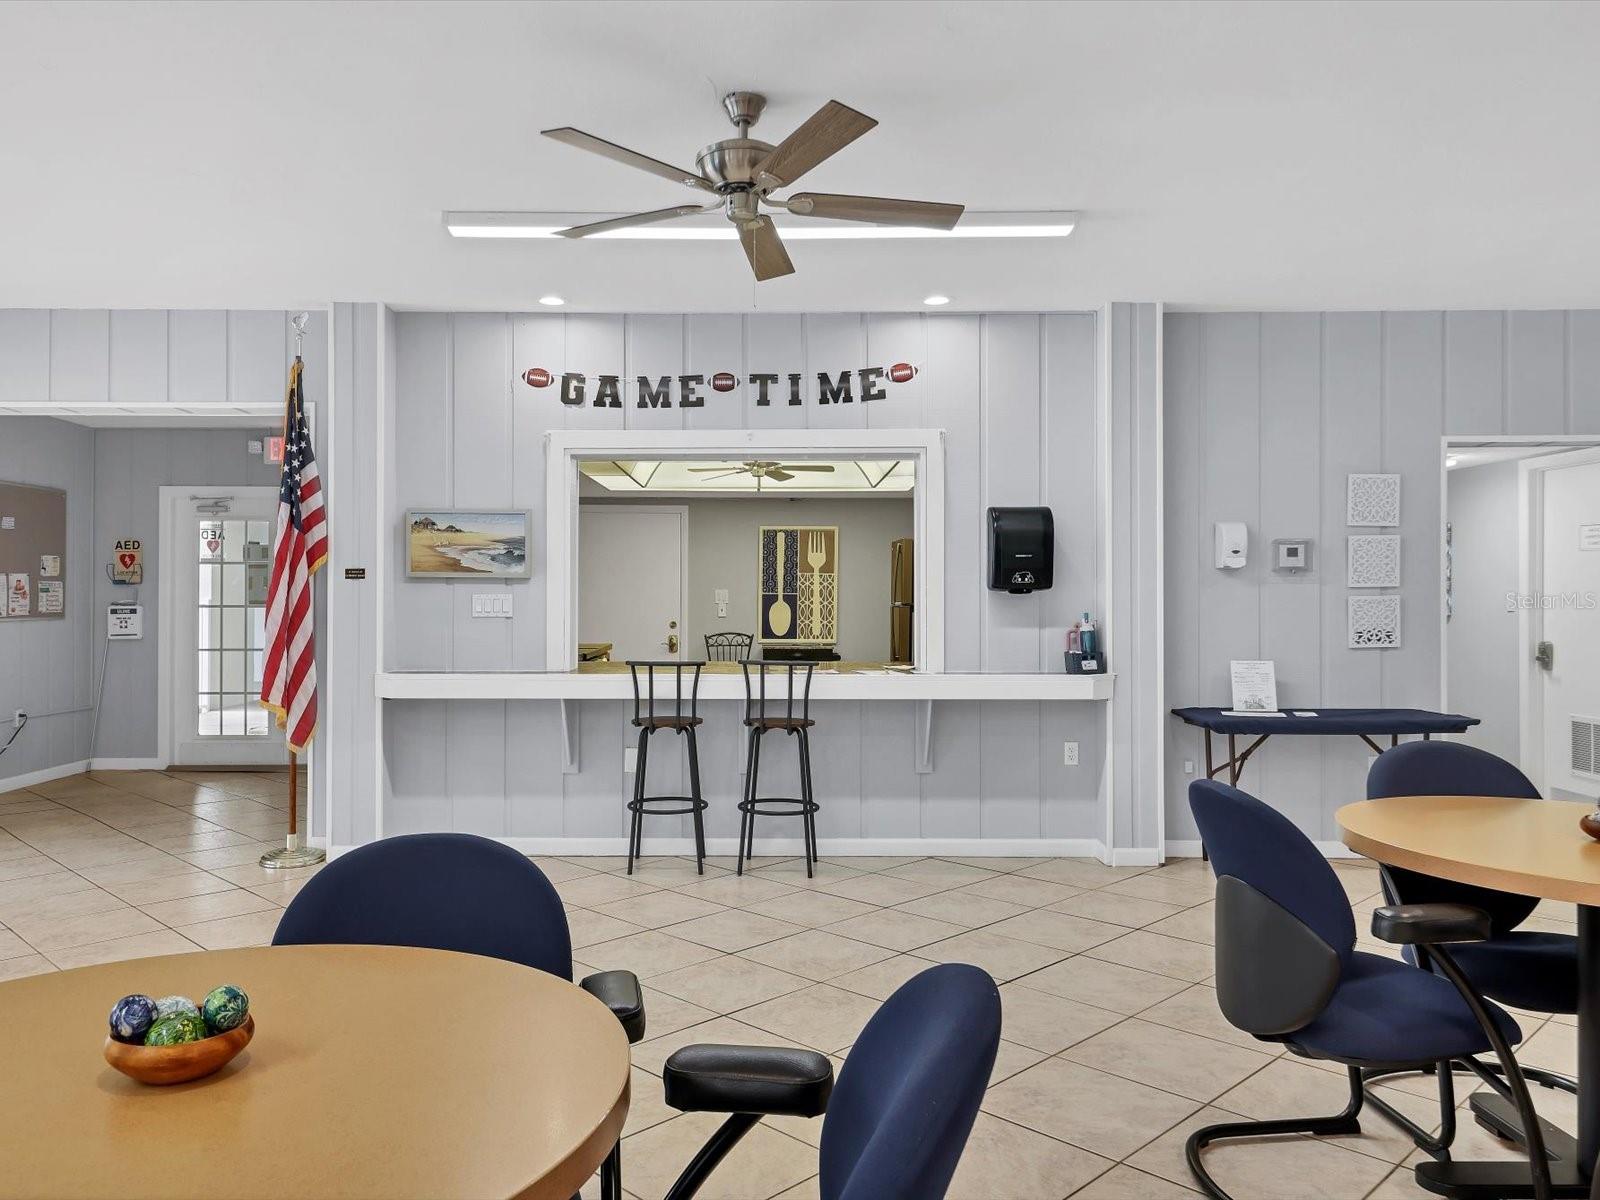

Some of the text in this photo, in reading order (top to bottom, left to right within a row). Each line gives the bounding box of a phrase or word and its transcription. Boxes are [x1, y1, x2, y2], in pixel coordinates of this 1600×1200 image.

[560, 367, 887, 408] GAME TIME
[115, 540, 140, 551] AED
